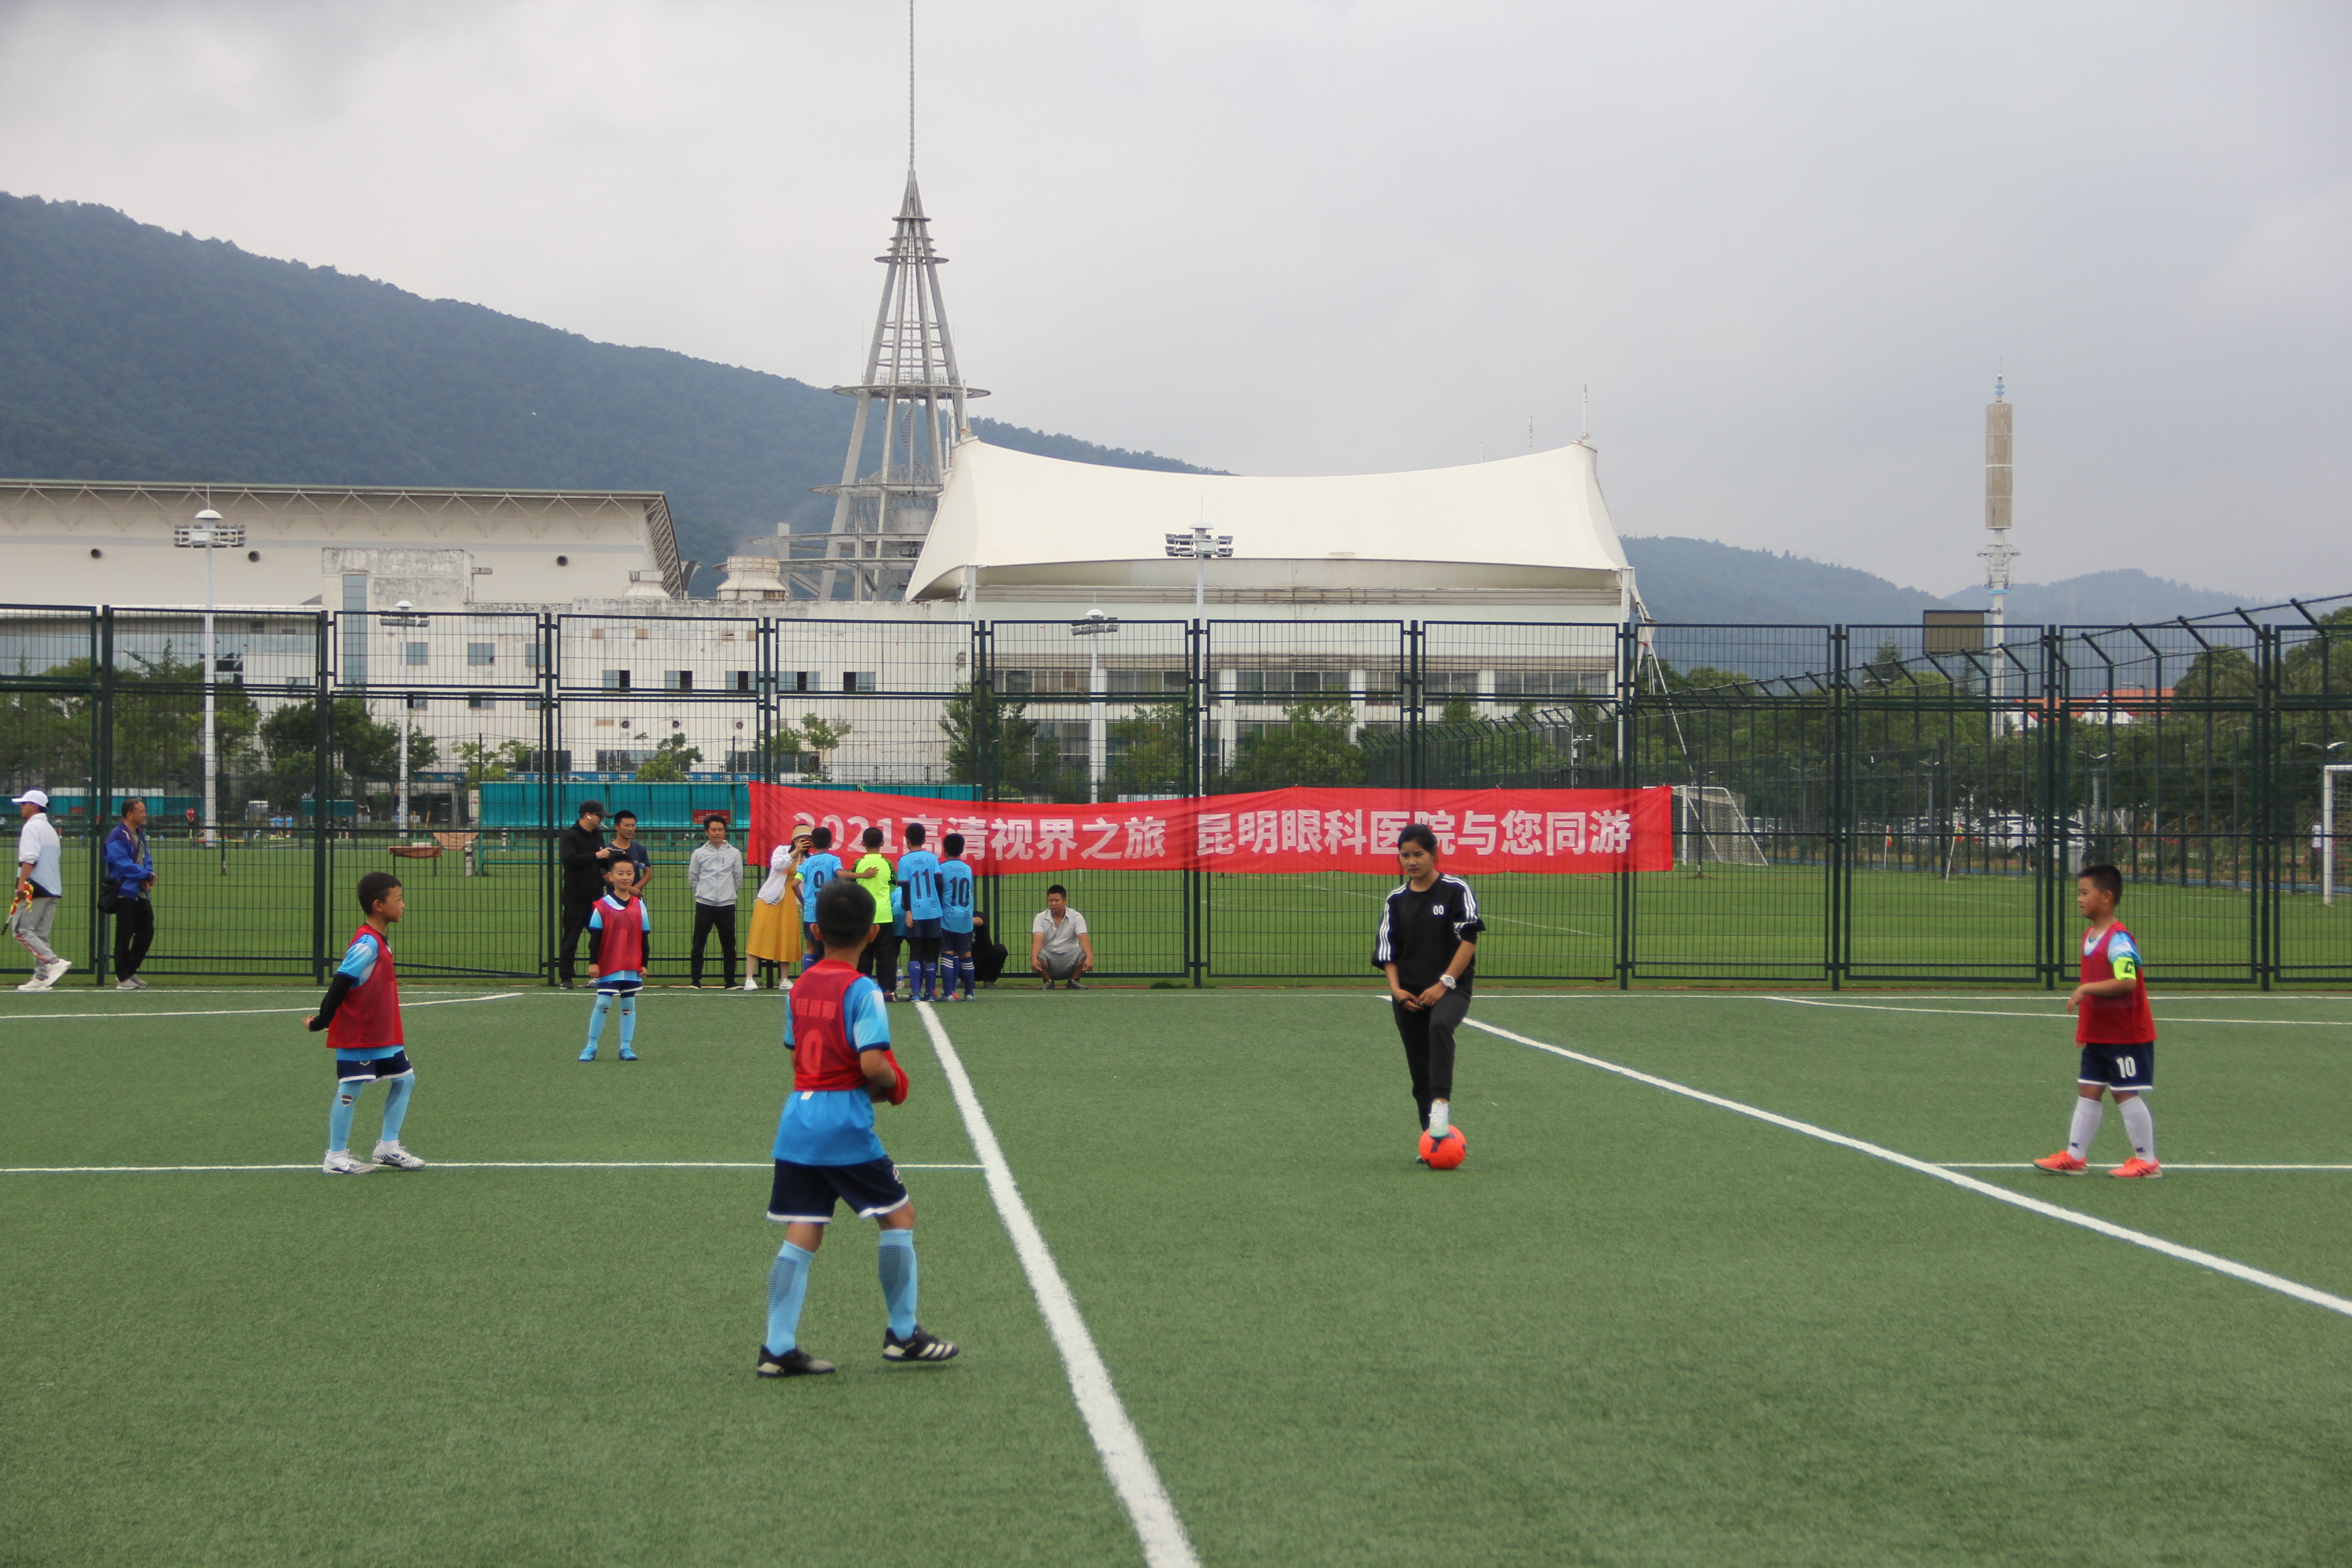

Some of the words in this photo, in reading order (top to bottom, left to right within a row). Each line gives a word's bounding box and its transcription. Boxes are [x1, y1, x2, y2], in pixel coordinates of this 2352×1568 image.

[1196, 809, 1631, 856] 昆明眼科医院与您同游
[912, 868, 931, 900] 11
[949, 877, 970, 907] 10
[2124, 961, 2134, 973] C
[2117, 1056, 2136, 1078] 10
